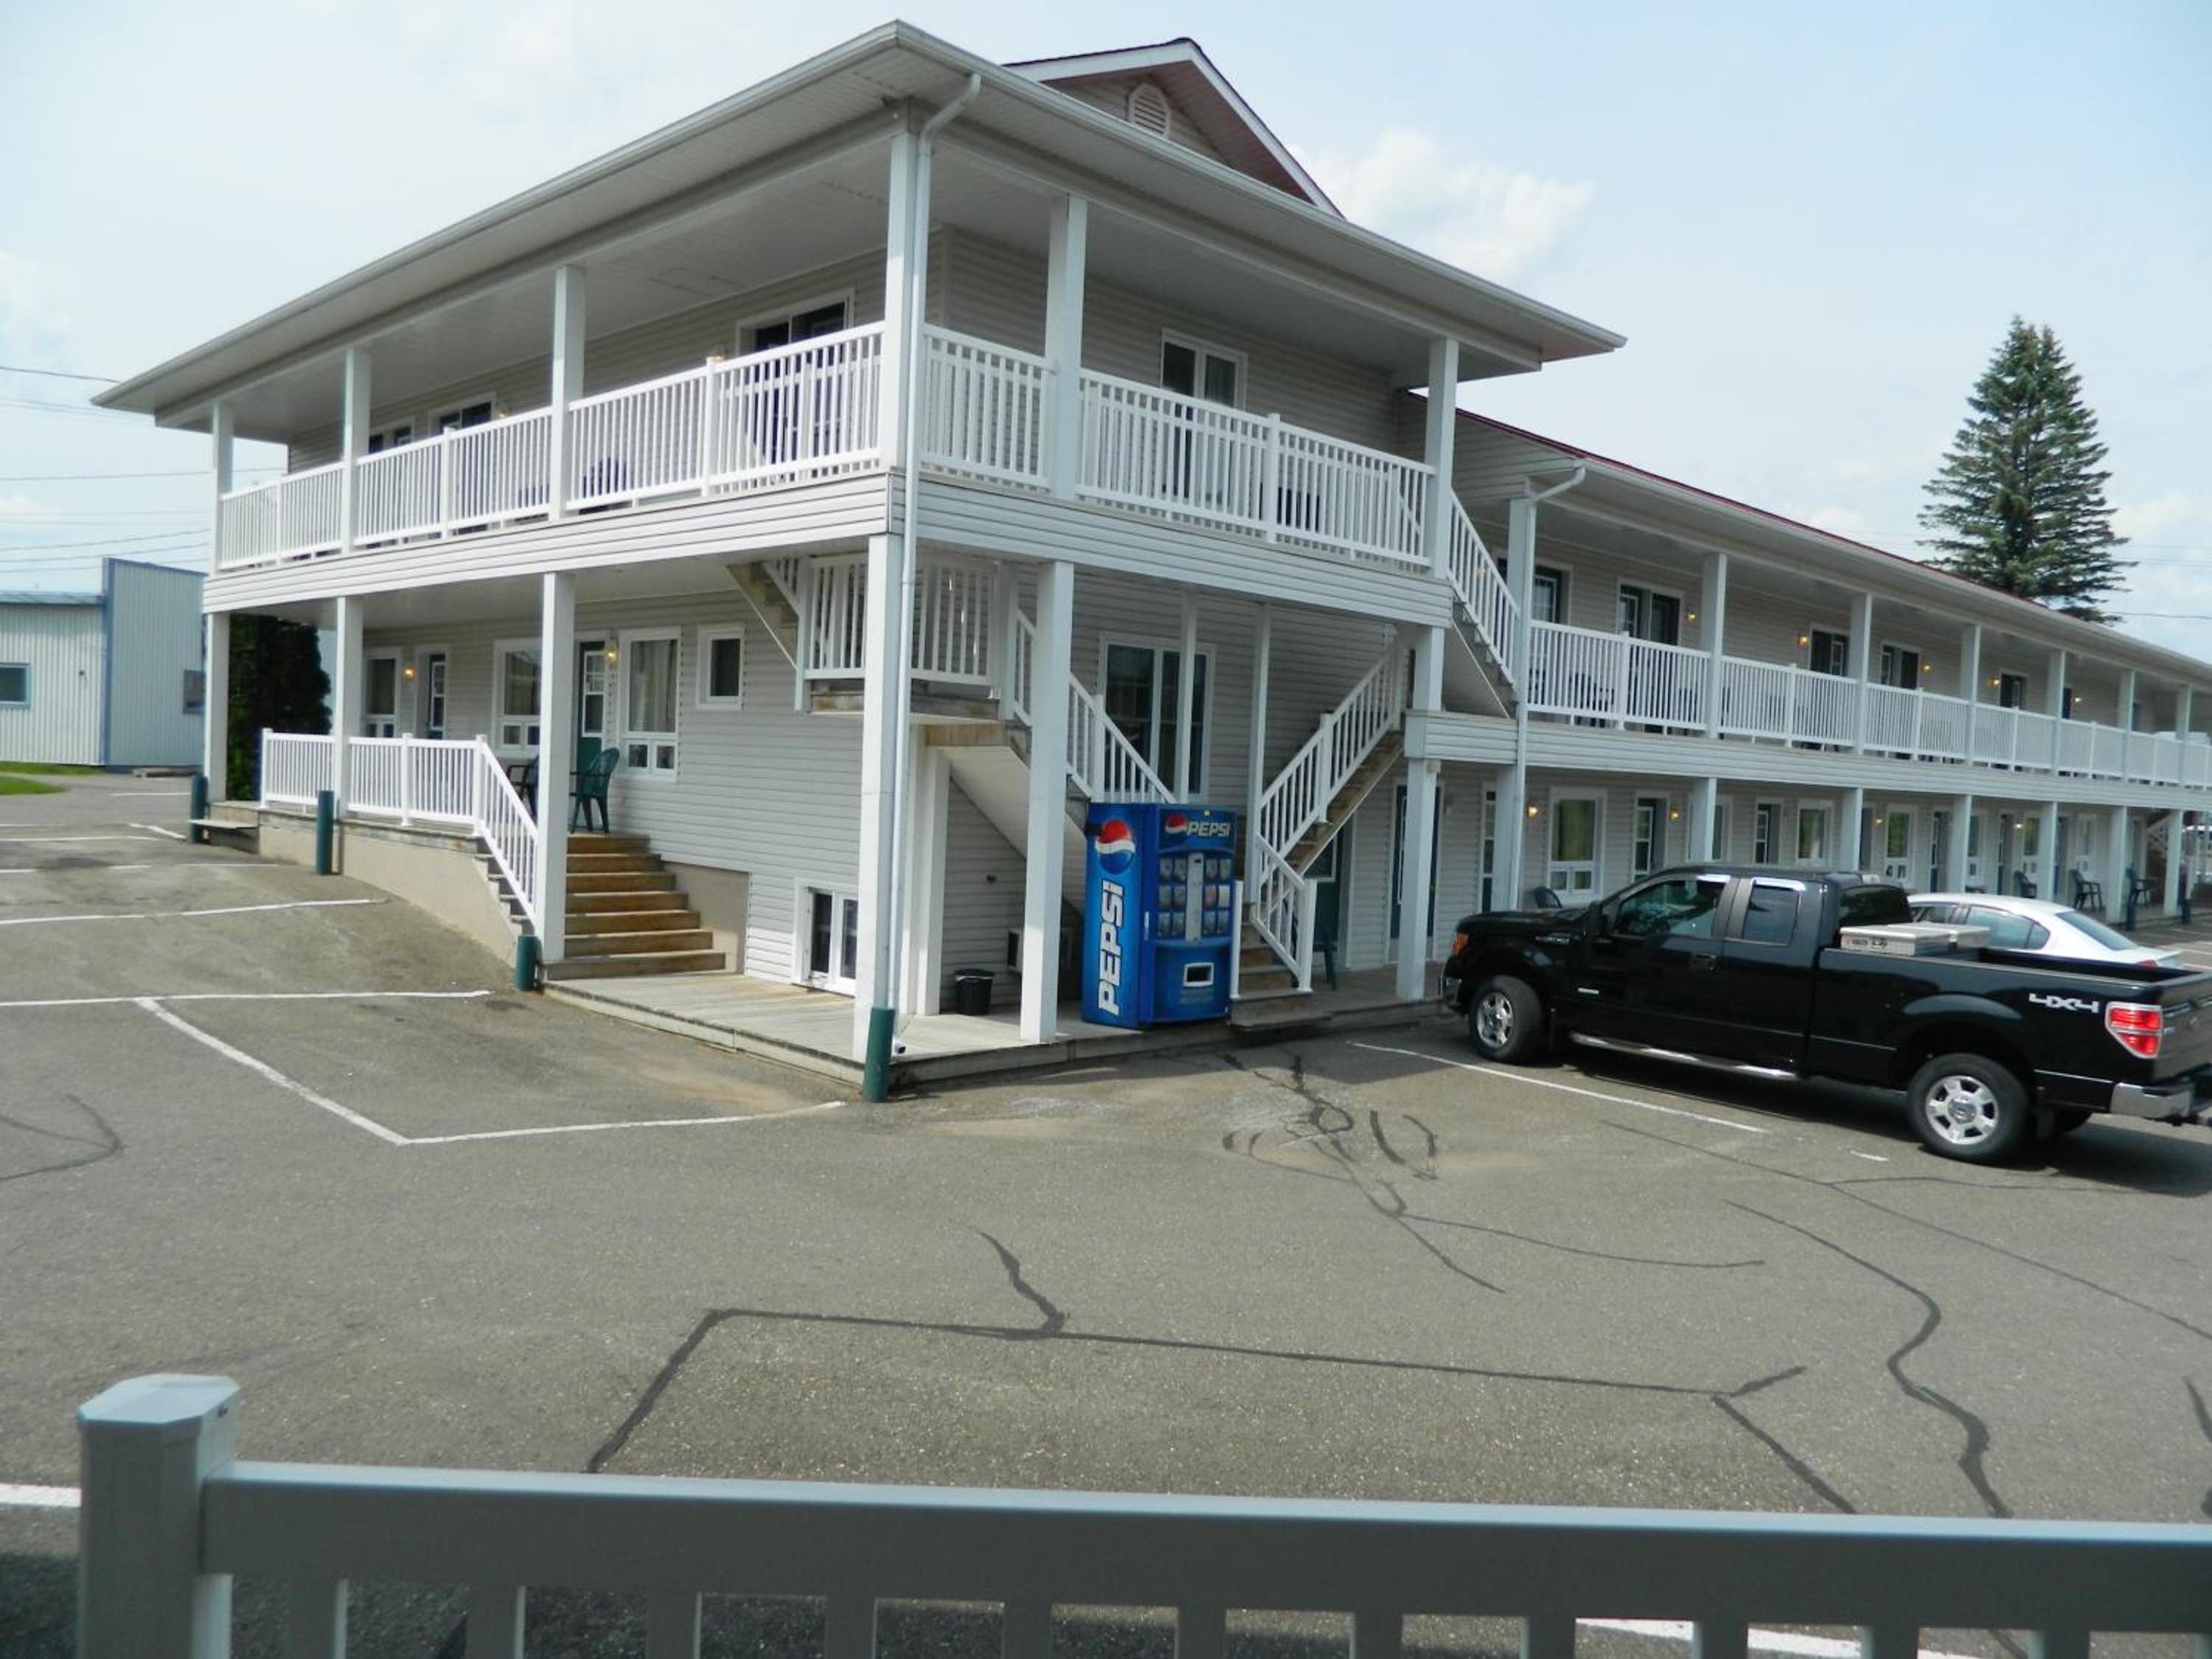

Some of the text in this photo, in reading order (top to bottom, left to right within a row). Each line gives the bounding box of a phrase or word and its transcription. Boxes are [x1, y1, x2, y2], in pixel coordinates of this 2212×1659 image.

[1186, 821, 1231, 838] PEPSI
[1098, 879, 1124, 1015] PEPSI
[2028, 993, 2100, 1014] 4X4
